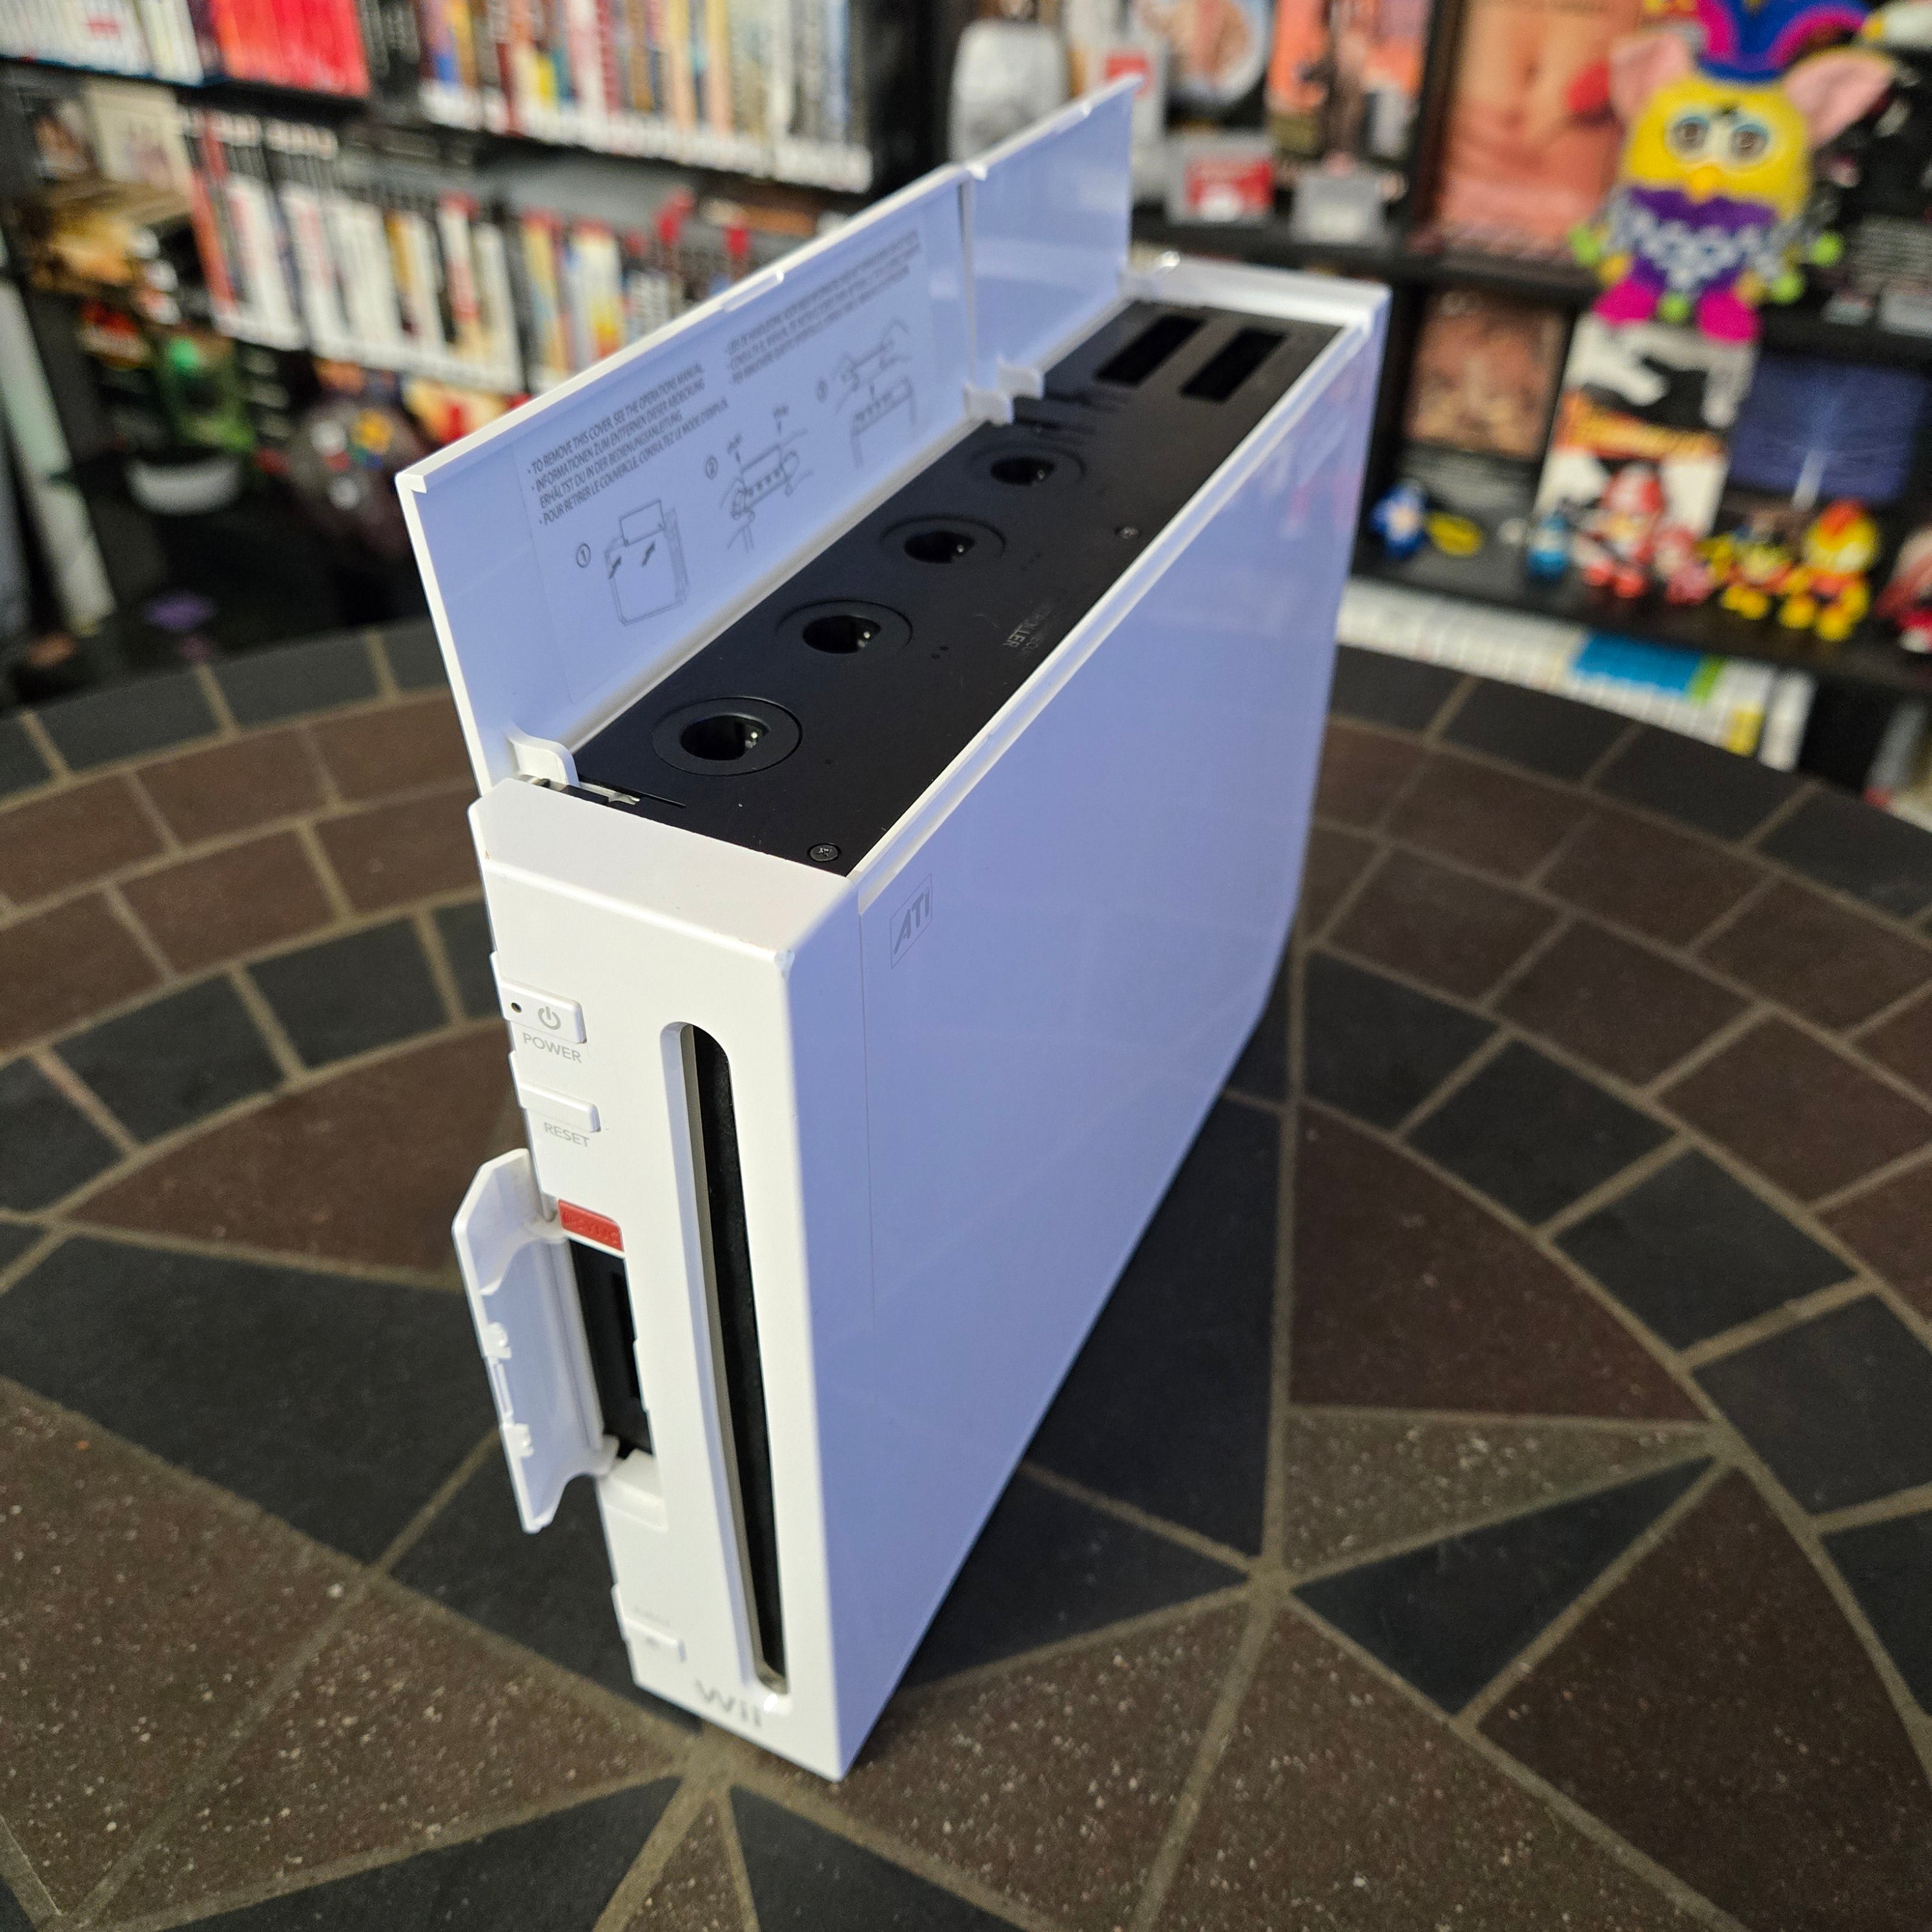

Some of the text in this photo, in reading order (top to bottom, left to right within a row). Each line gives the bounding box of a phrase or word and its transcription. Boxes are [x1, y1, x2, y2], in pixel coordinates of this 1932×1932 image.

[531, 457, 544, 475] TO
[542, 439, 573, 468] REMOVE
[572, 430, 589, 449] THIS
[535, 446, 593, 493] INFORMATIONEN
[593, 436, 611, 456] ZUM
[573, 470, 586, 487] DU
[585, 464, 595, 479] IN
[593, 455, 609, 474] DER
[542, 503, 564, 526] POUR
[894, 886, 930, 955] ATI
[522, 1033, 582, 1064] POWER
[544, 1122, 590, 1147] RESET
[694, 1678, 762, 1728] Wii
